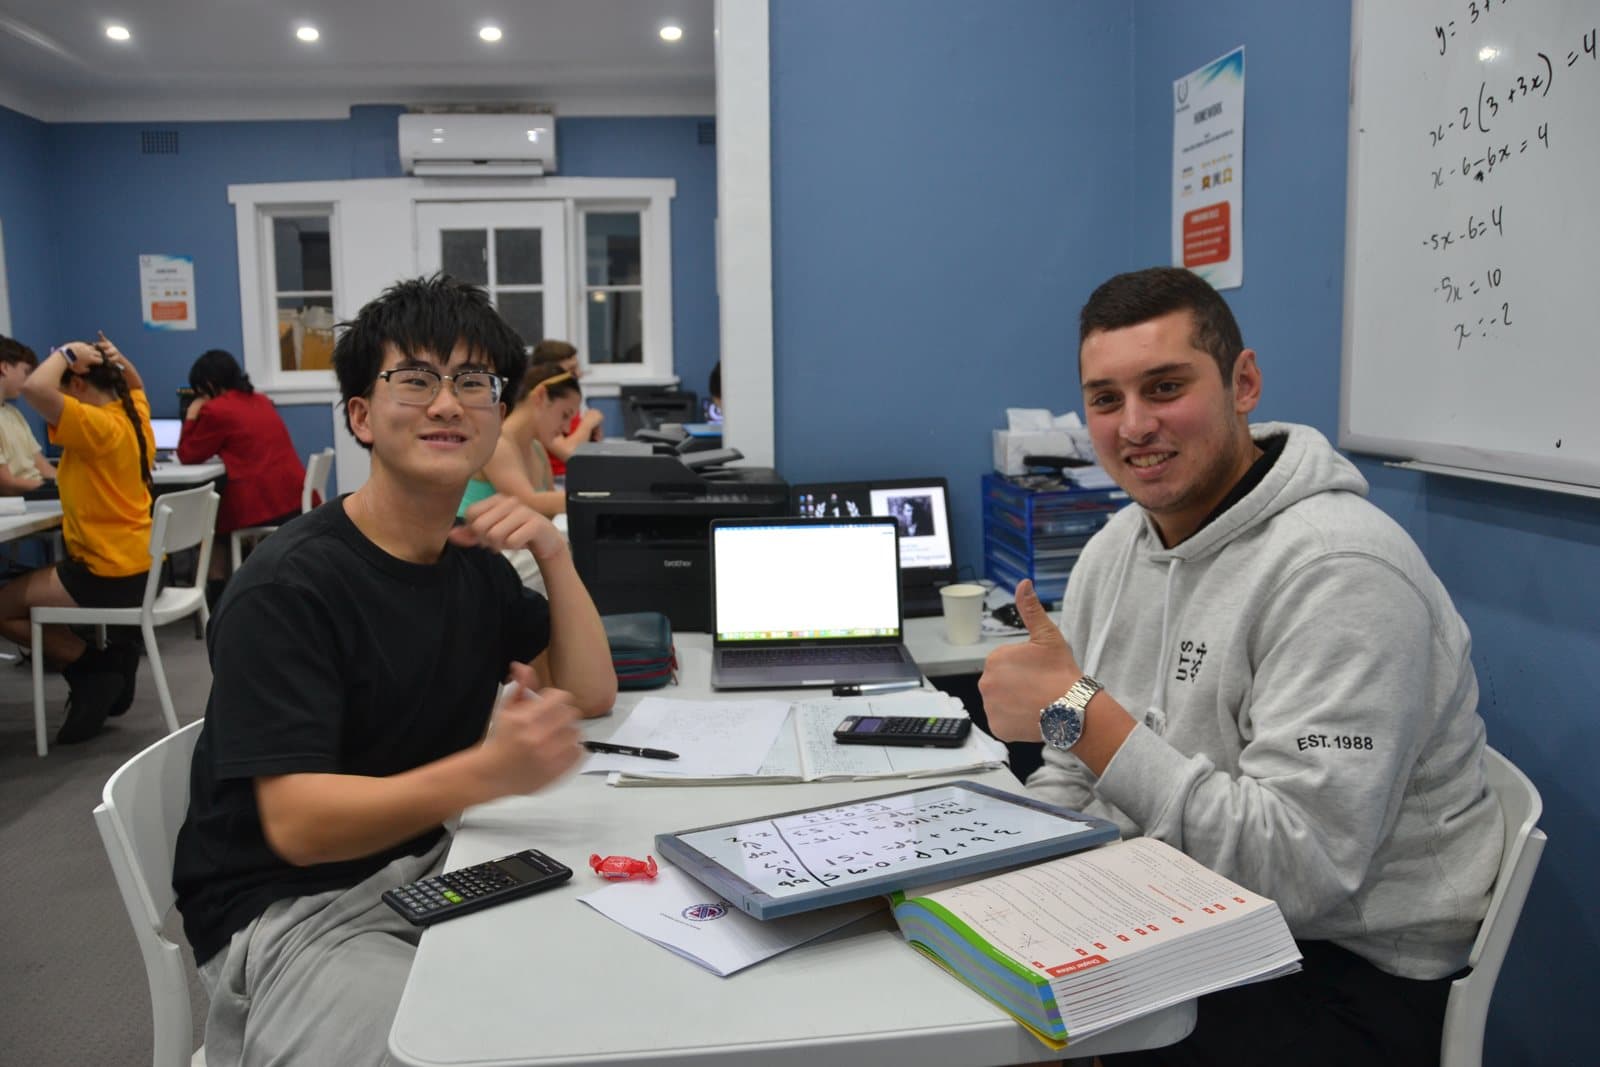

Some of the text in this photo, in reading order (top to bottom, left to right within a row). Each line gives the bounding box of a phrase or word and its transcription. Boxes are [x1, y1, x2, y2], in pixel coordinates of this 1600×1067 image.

[1175, 640, 1194, 682] UTS
[1297, 734, 1374, 751] EST. 1988
